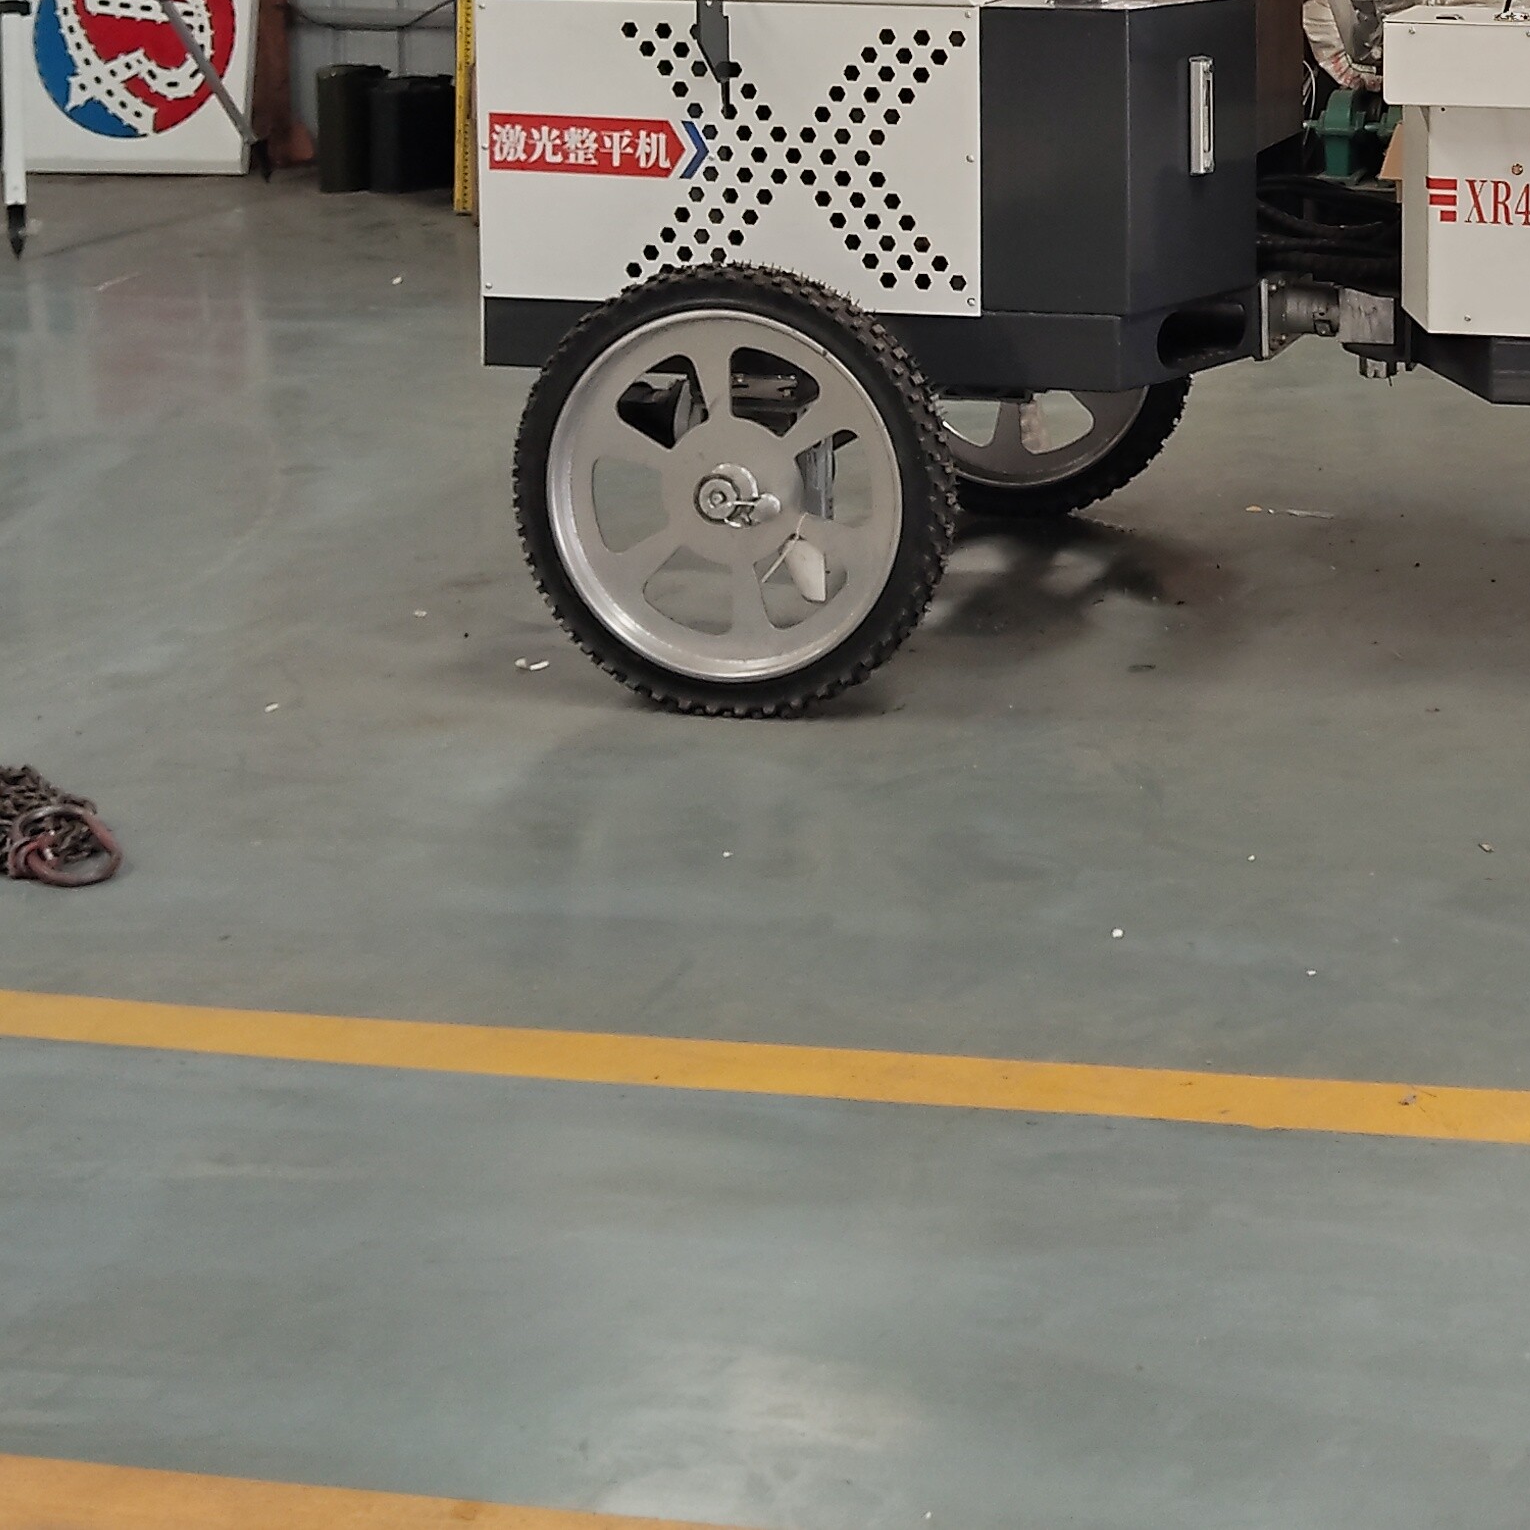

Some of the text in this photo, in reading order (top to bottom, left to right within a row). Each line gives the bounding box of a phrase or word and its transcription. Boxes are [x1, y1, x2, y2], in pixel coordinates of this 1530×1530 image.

[492, 124, 672, 169] 激光整平机
